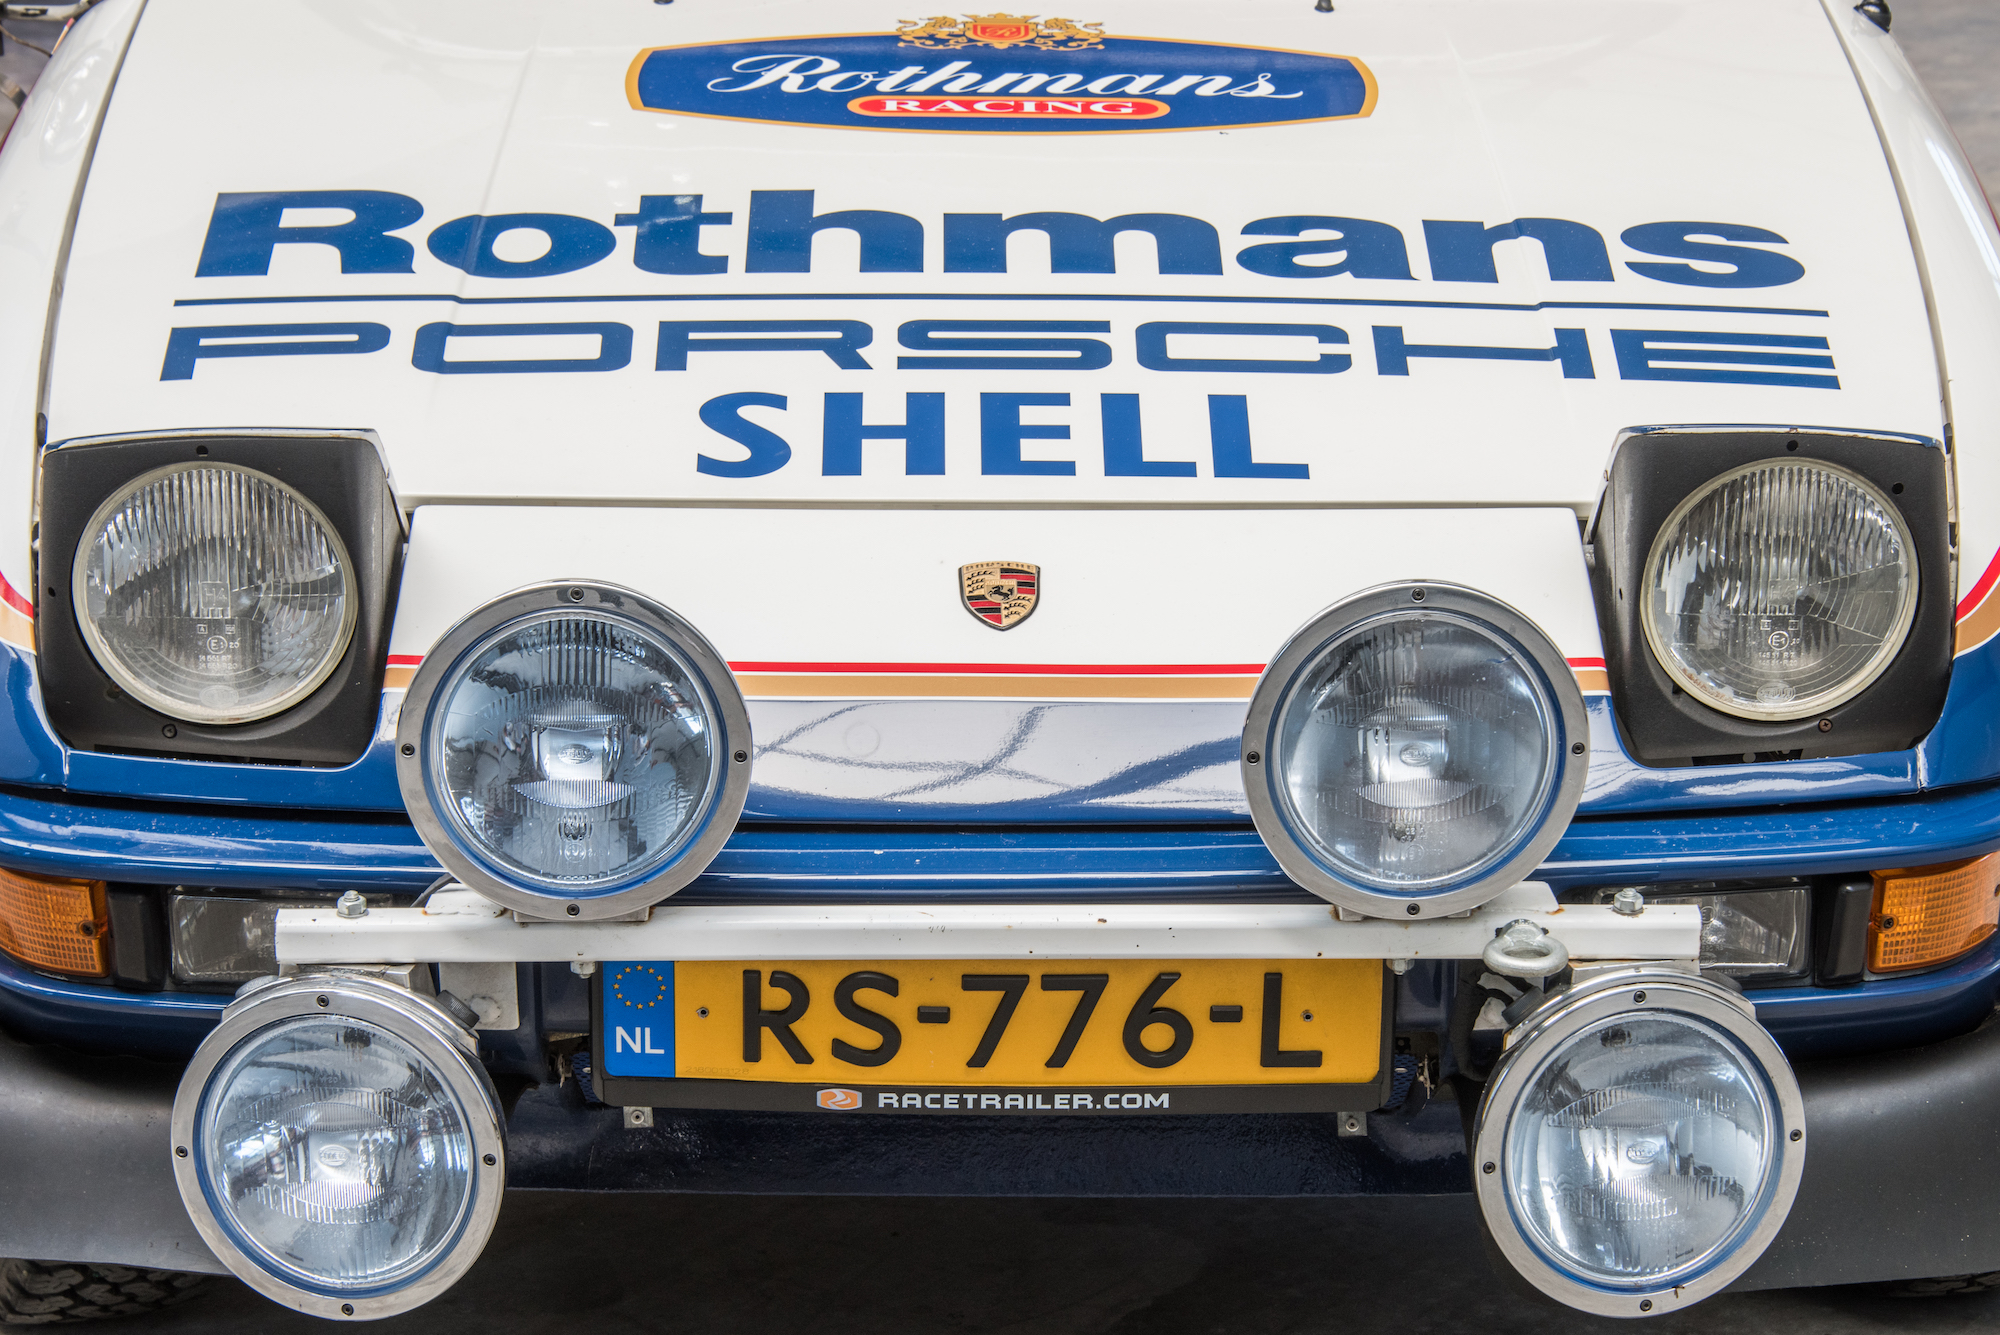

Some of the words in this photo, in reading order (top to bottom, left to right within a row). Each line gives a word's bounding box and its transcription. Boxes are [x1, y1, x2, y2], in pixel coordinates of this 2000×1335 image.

[706, 54, 1304, 99] Rothmans
[883, 99, 1138, 115] RACING
[195, 189, 1806, 289] Rothmans
[159, 320, 1841, 390] PORSCHE
[696, 391, 1310, 480] SHELL
[615, 1026, 665, 1055] NL
[742, 968, 1323, 1069] RS-776-L
[878, 1093, 1170, 1109] RACETRAILER.COM
